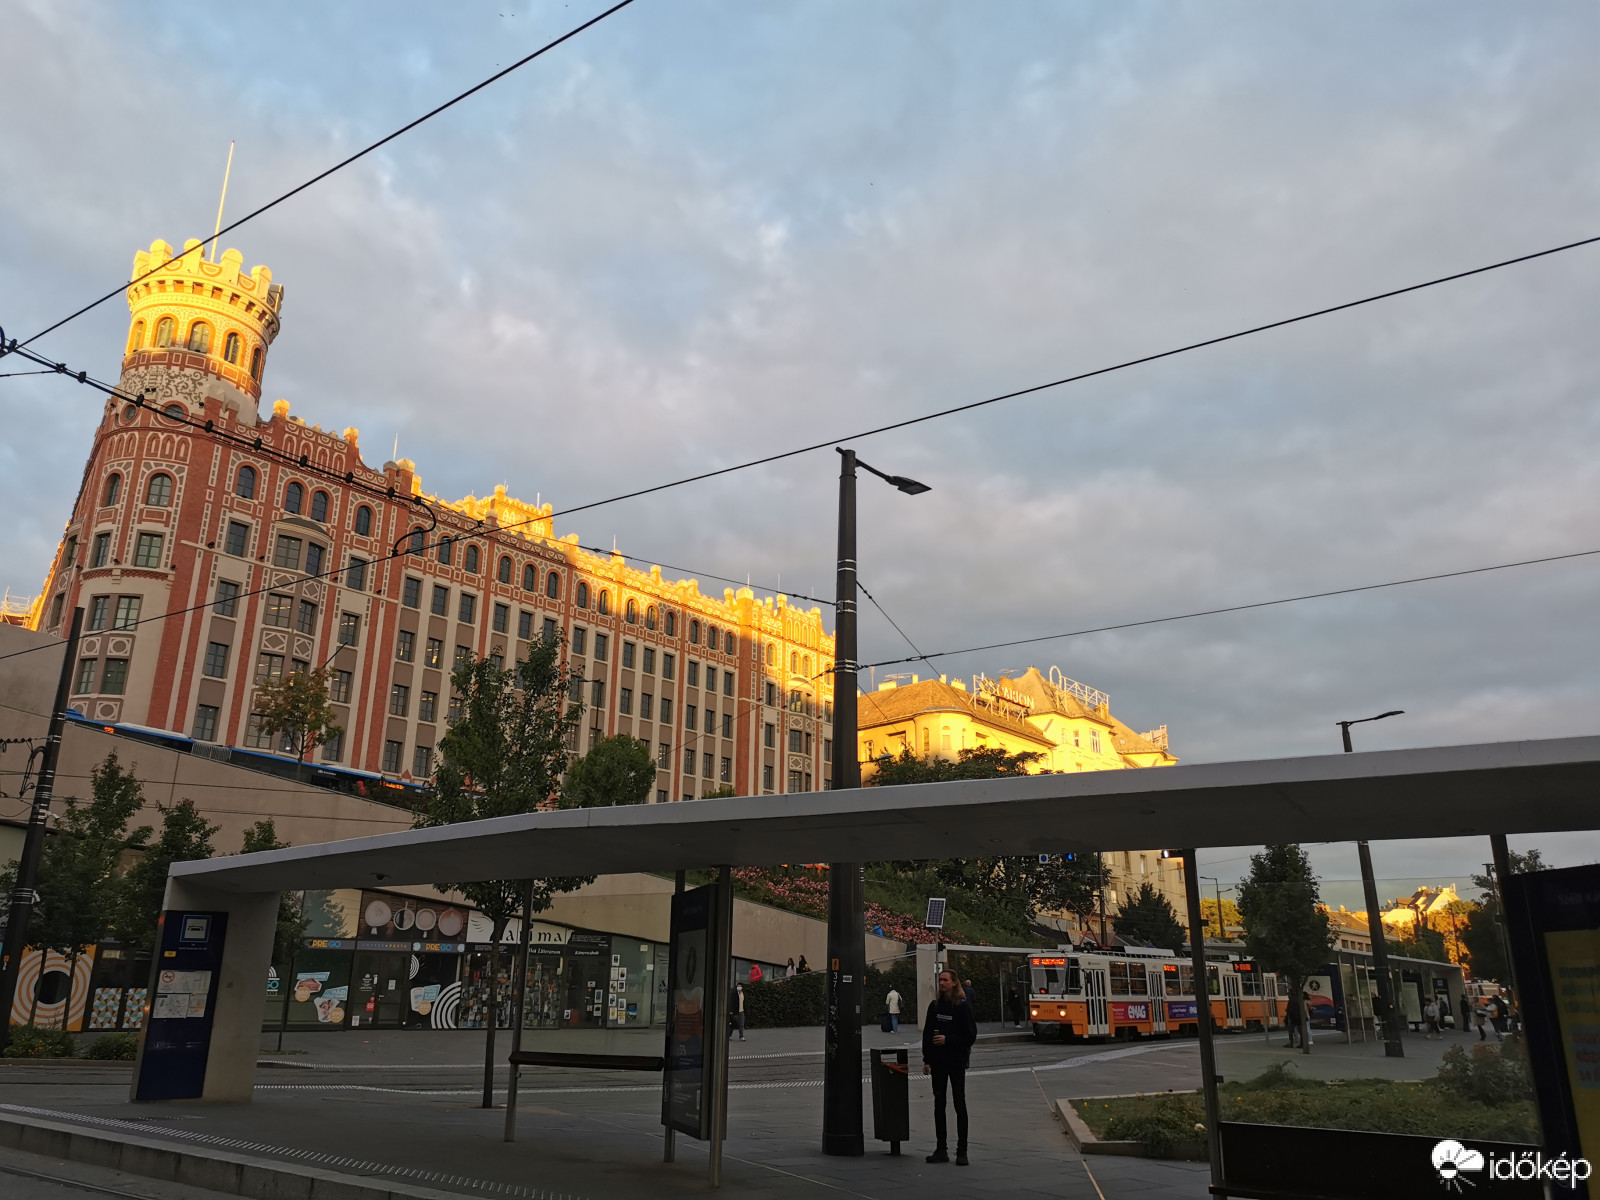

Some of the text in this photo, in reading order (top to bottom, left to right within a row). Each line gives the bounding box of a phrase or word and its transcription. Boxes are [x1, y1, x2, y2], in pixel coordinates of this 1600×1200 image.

[312, 939, 341, 948] PREGO
[425, 943, 452, 951] PREGO
[1128, 1005, 1146, 1019] eMAG
